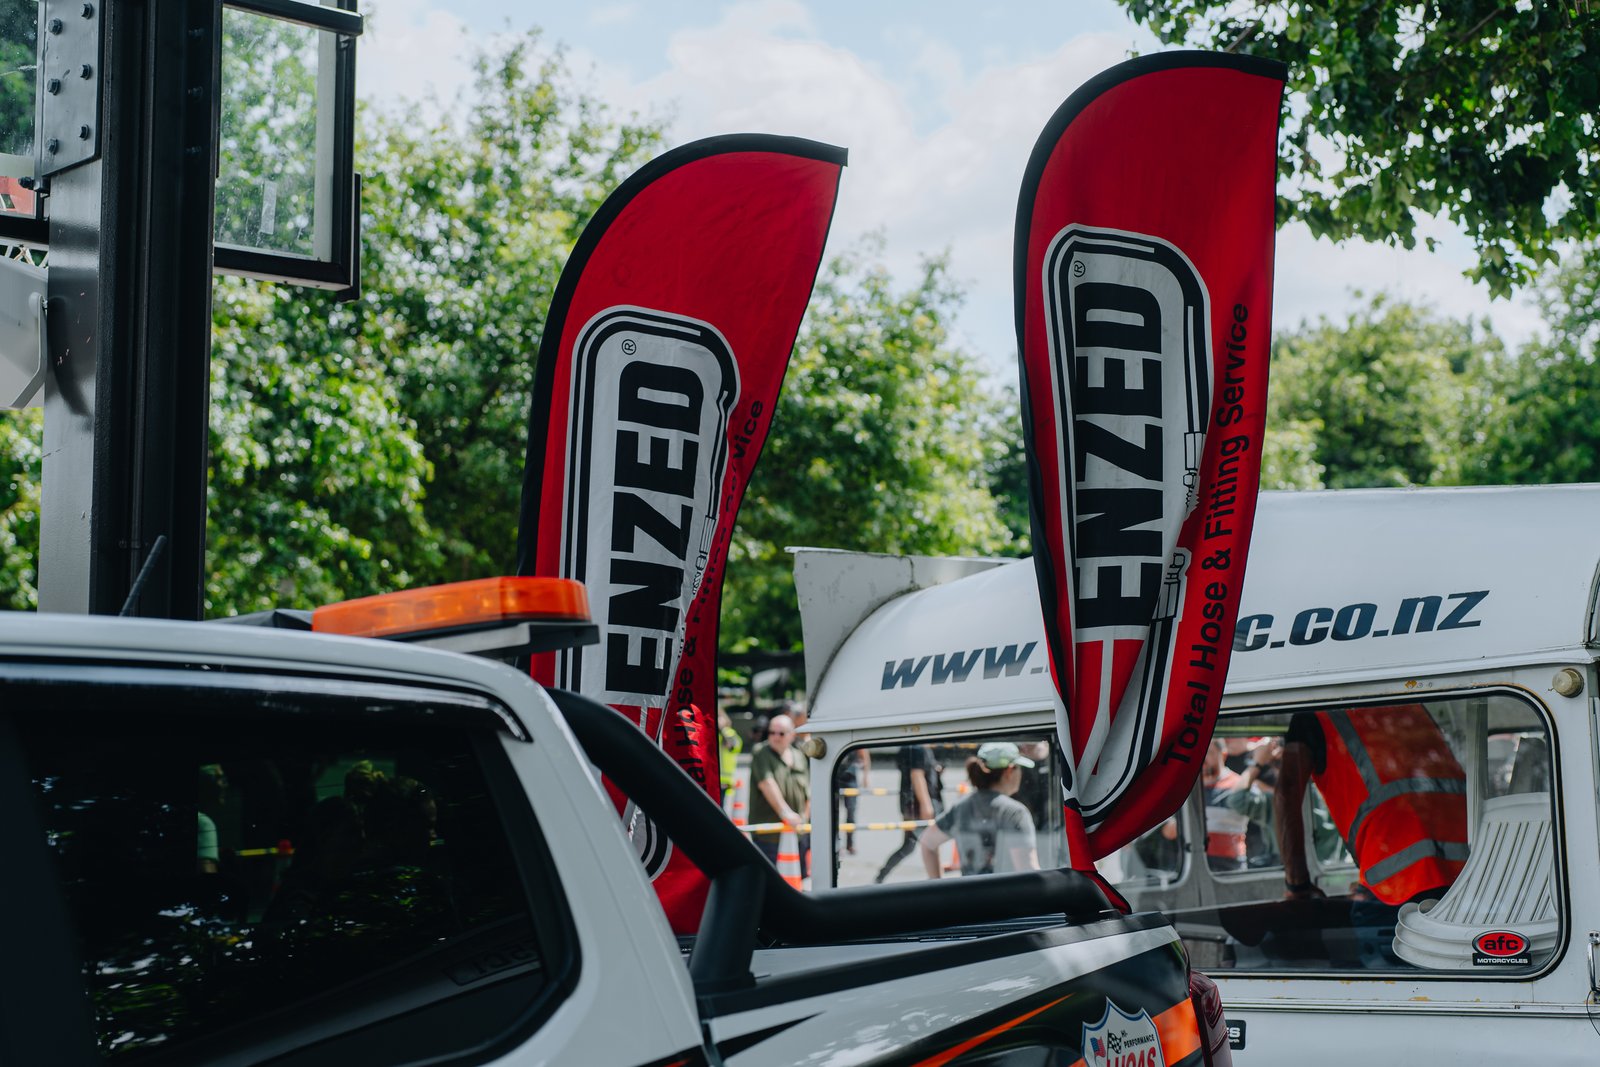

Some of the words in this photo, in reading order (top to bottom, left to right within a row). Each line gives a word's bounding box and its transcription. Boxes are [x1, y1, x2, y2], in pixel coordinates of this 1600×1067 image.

[1216, 303, 1249, 428] Service
[1075, 282, 1163, 628] ENZED
[1204, 434, 1249, 540] Fitting
[605, 361, 704, 696] ENZED
[1202, 548, 1231, 571] &
[1190, 581, 1228, 671] Hose
[1161, 681, 1210, 765] Total
[1484, 936, 1518, 951] afc
[1124, 1034, 1155, 1048] PERFORMANCE
